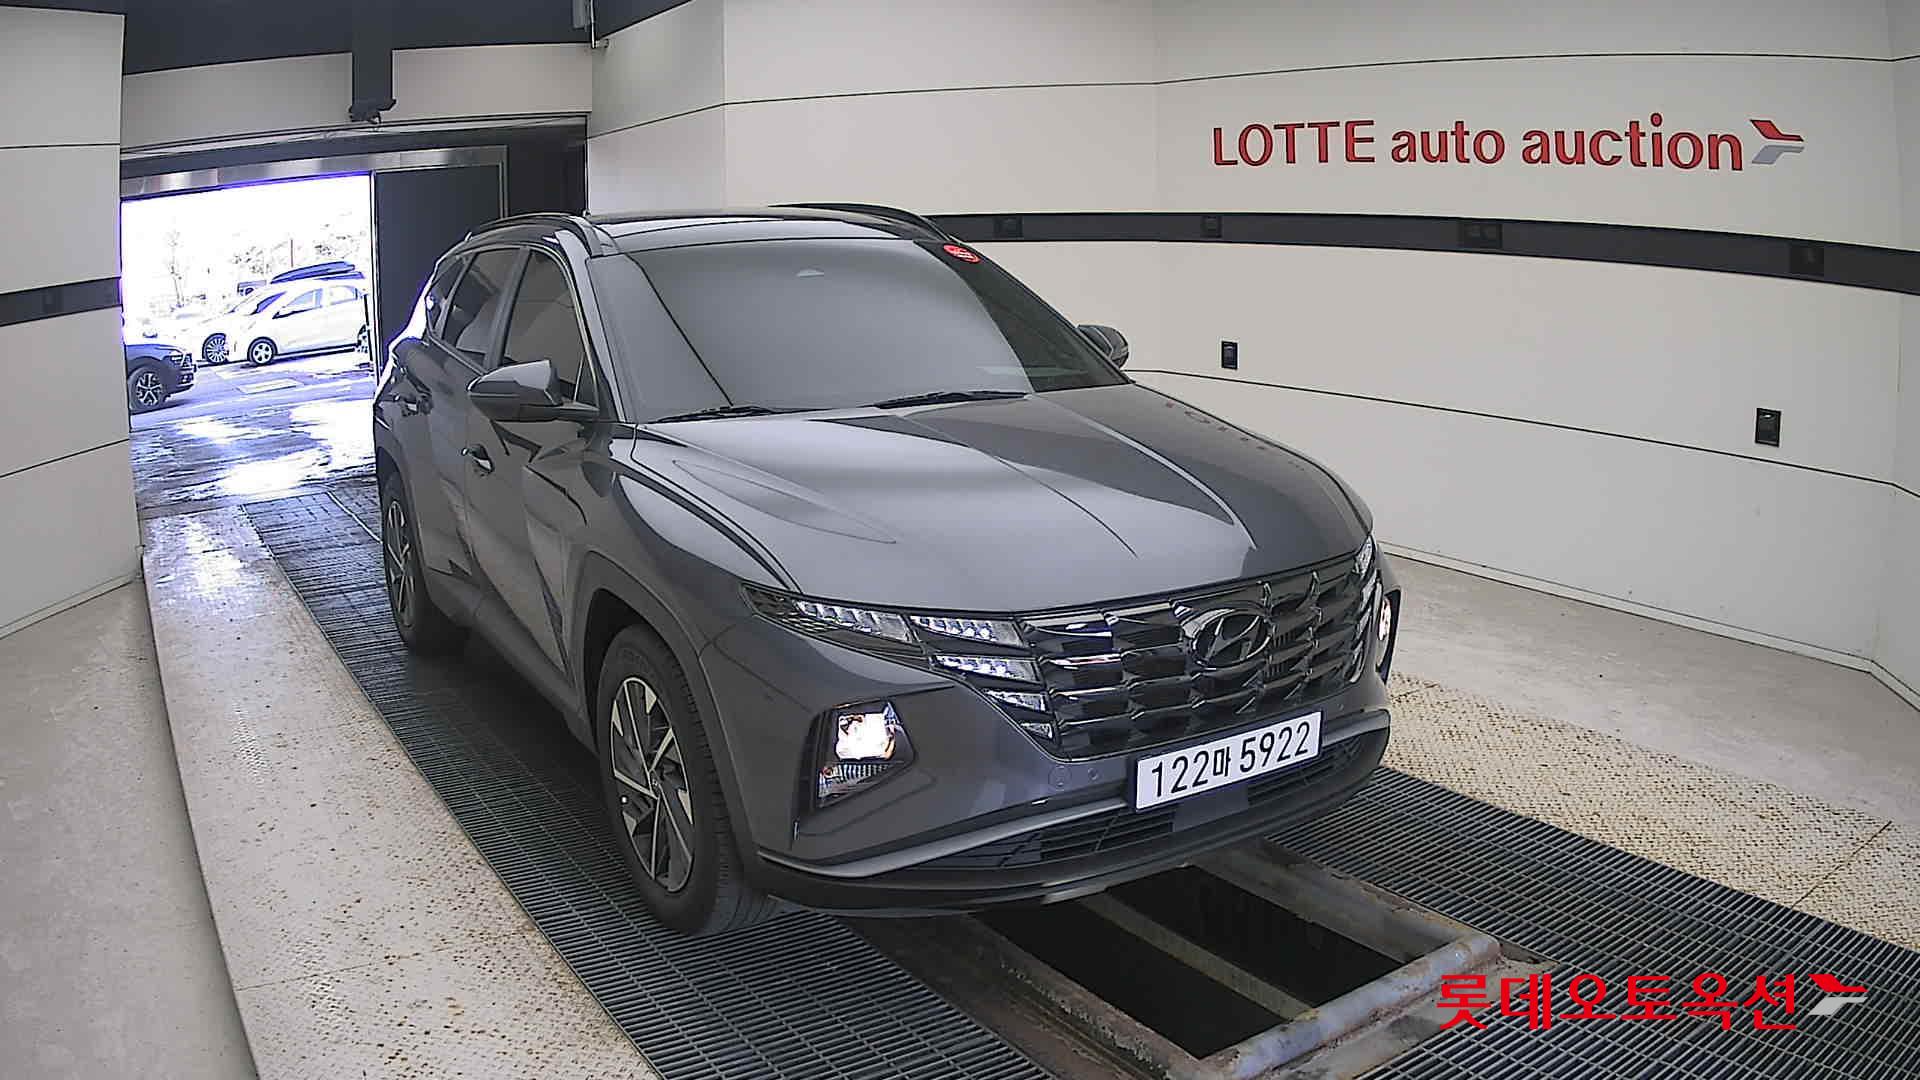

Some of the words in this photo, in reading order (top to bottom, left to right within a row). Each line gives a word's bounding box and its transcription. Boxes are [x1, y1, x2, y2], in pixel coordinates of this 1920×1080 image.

[1213, 120, 1376, 167] LOTTE
[1390, 121, 1507, 166] auto
[1520, 112, 1744, 172] auction
[1150, 746, 1232, 799] 122마
[1239, 720, 1310, 774] 5922
